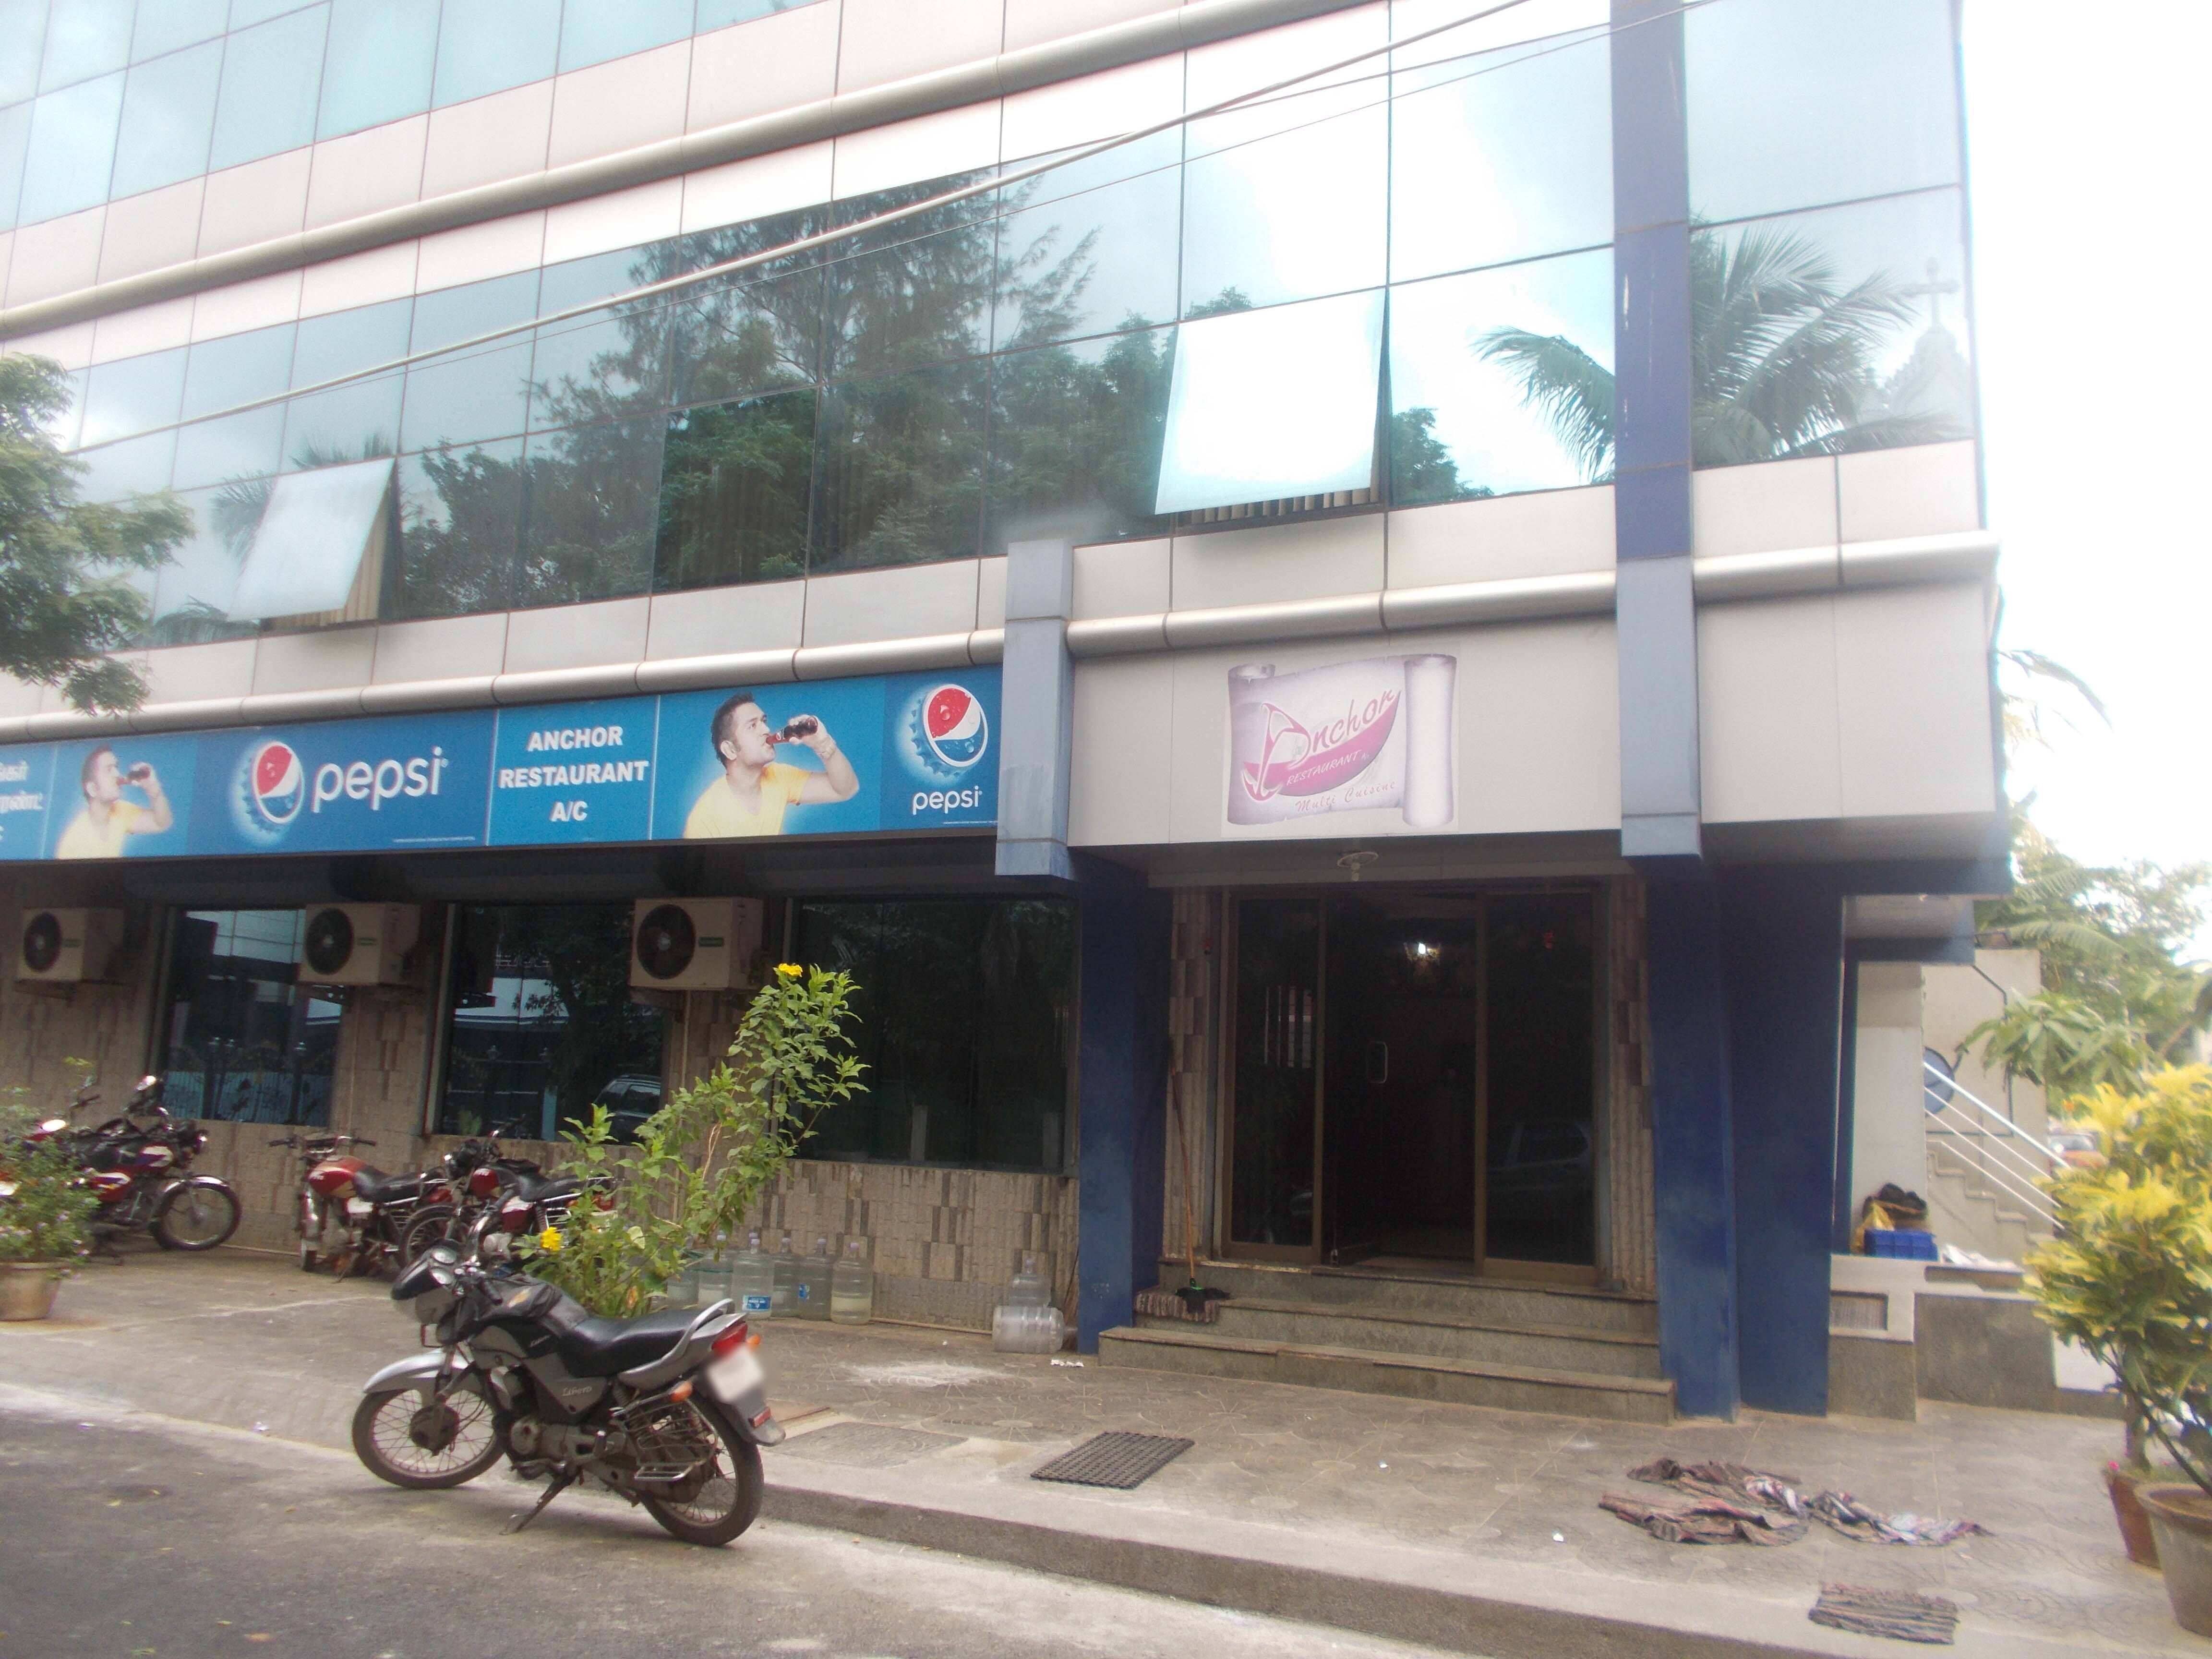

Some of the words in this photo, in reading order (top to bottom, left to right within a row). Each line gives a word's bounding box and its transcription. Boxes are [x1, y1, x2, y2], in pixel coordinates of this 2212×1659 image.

[527, 725, 624, 752] ANCHOR
[311, 746, 445, 813] pepsi
[498, 760, 649, 789] RESTAURANT
[1286, 748, 1362, 786] RESTAURANT
[550, 801, 588, 822] A/C
[913, 785, 980, 816] pepsi
[1295, 795, 1336, 812] Multi
